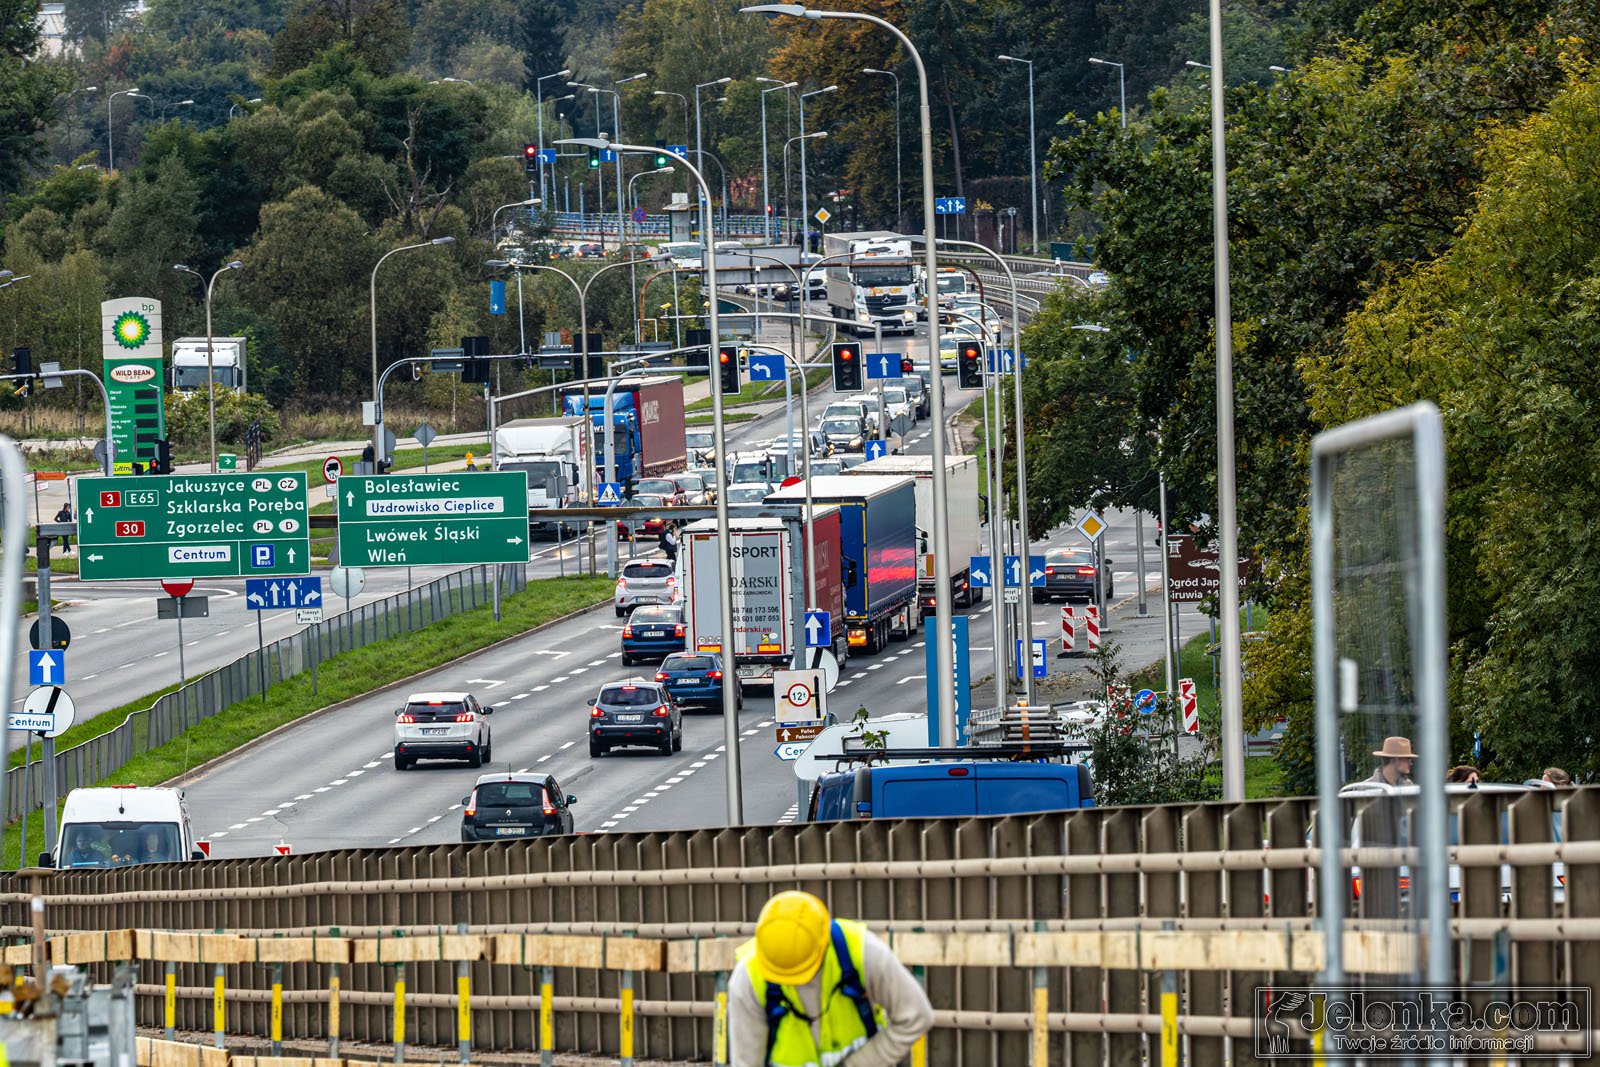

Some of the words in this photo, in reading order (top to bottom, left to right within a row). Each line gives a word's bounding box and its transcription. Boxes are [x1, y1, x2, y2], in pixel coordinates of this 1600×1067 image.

[142, 303, 154, 312] bp
[166, 480, 244, 495] Jakuszyce
[255, 481, 268, 490] PL
[280, 480, 294, 489] CZ
[365, 478, 460, 494] Bolesławiec
[106, 494, 114, 504] 3
[167, 500, 242, 514] Szklarska
[248, 498, 304, 514] Poręba
[372, 501, 440, 513] Uzdrowisko
[444, 500, 495, 514] Cieplice
[122, 524, 138, 534] 30
[167, 520, 244, 538] Zgorzelec
[256, 522, 270, 531] PL
[285, 522, 293, 530] D
[366, 527, 428, 542] Lwówek
[434, 523, 480, 544] Śląski
[174, 549, 226, 560] Centrum
[367, 548, 407, 562] Wleń
[1170, 590, 1203, 599] iruwia
[792, 692, 806, 701] 12t
[8, 716, 50, 727] Centrum
